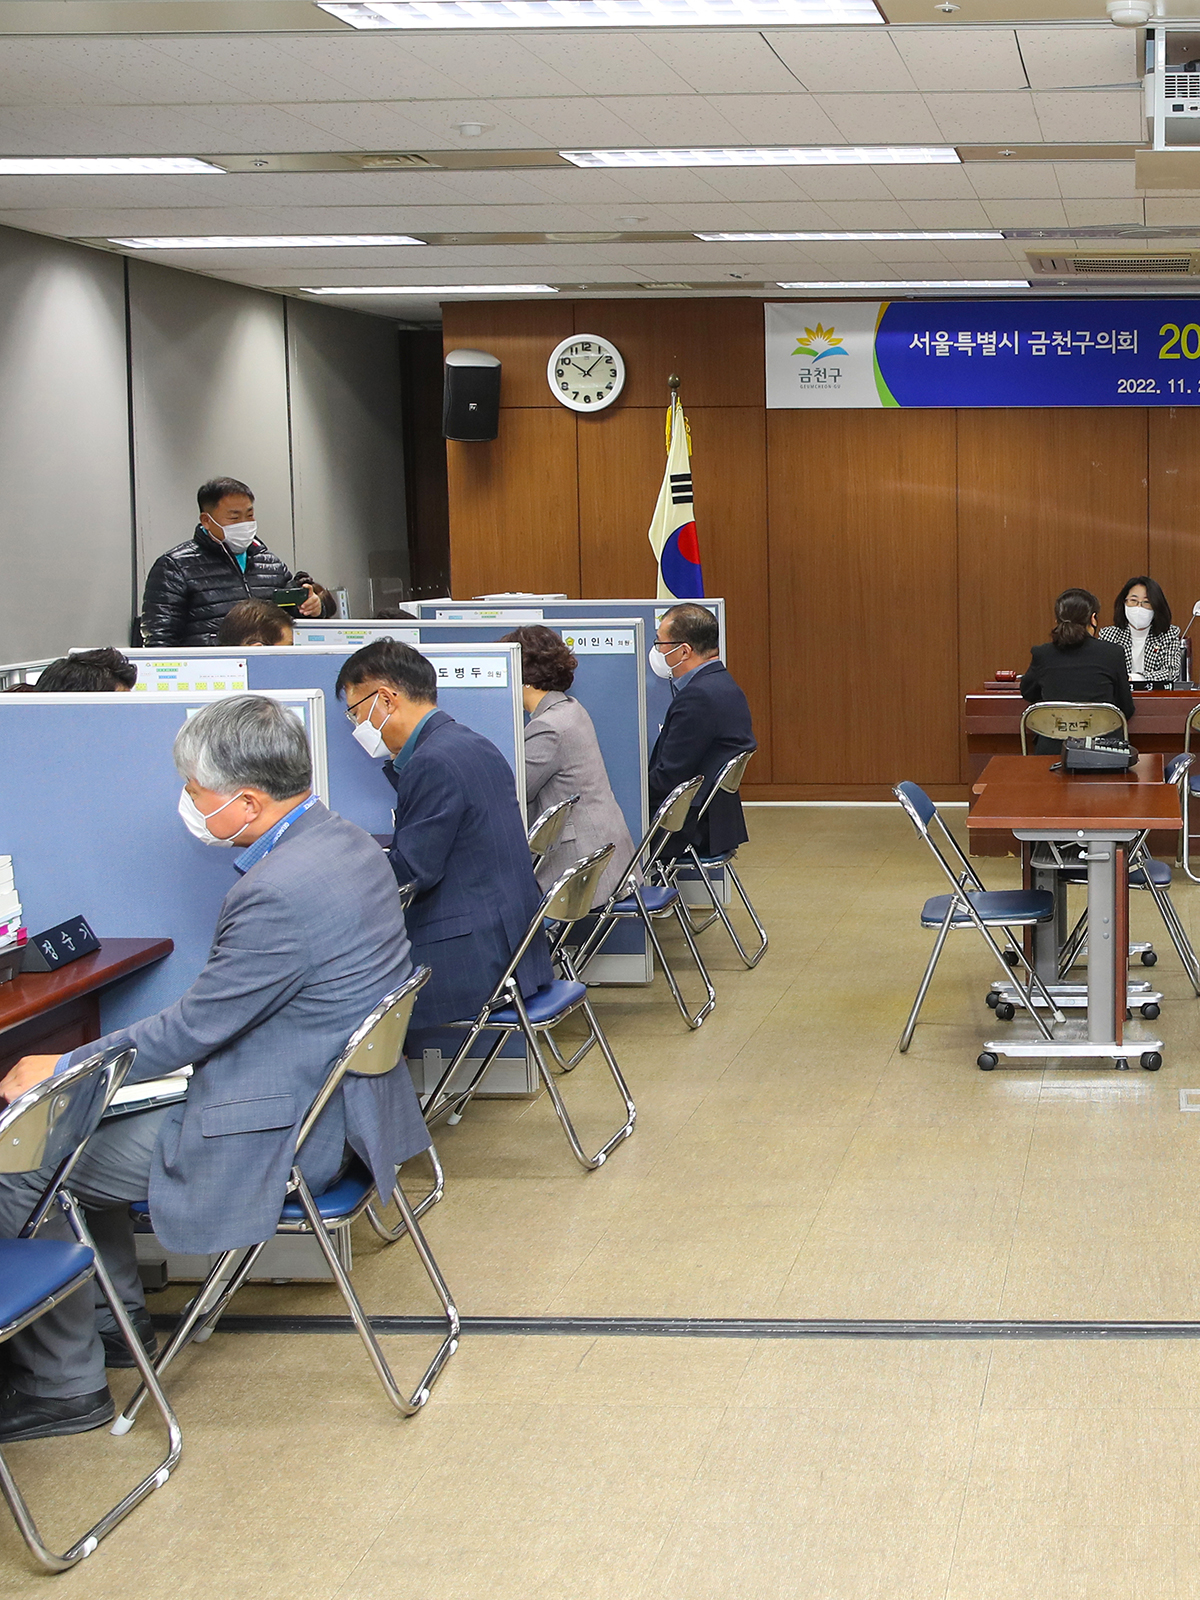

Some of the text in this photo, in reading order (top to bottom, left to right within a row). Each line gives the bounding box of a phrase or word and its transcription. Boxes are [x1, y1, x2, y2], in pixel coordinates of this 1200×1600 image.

[581, 342, 592, 352] 12
[909, 330, 1019, 357] 서울특별시
[1027, 329, 1139, 356] 금천구의회
[570, 347, 578, 355] 11
[598, 346, 601, 354] 1
[560, 357, 571, 366] 10
[605, 356, 613, 364] 2
[556, 369, 564, 377] 9
[609, 369, 617, 377] 3
[798, 368, 842, 383] 금천구
[561, 382, 569, 391] 8
[605, 382, 613, 390] 4
[1117, 378, 1161, 394] 2022.
[1168, 378, 1192, 394] 11.
[572, 392, 579, 400] 7
[584, 395, 591, 403] 6
[596, 392, 604, 400] 5
[577, 637, 614, 647] 이인식
[438, 667, 482, 679] 도병두
